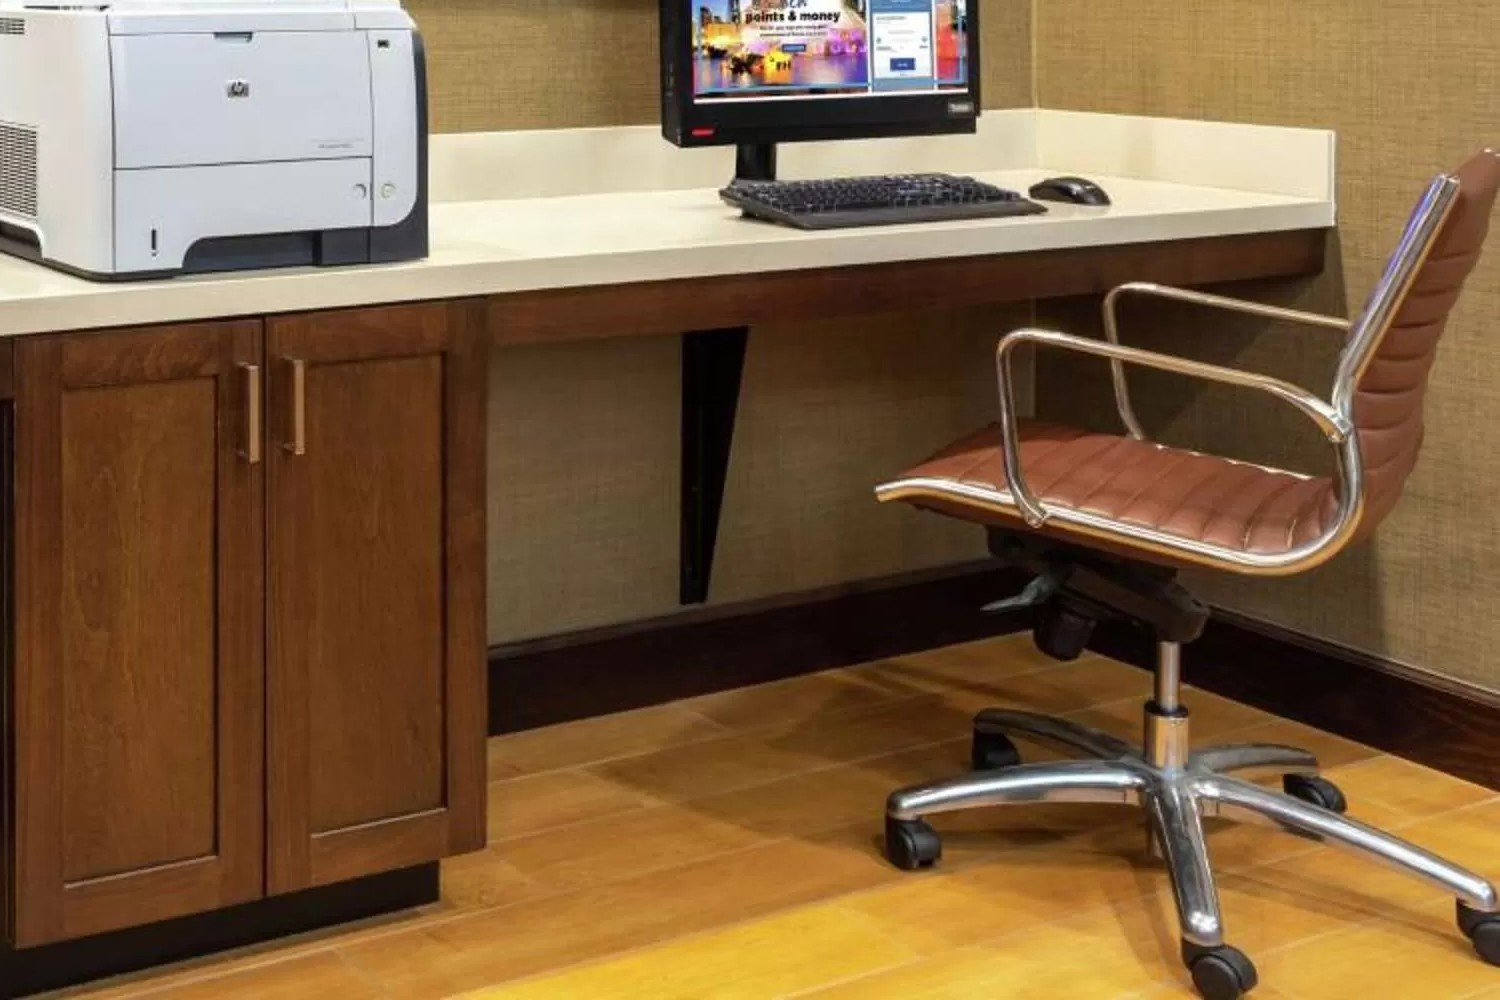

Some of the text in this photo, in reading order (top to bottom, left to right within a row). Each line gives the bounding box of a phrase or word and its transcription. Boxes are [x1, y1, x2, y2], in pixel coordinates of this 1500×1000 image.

[745, 10, 841, 24] points & money
